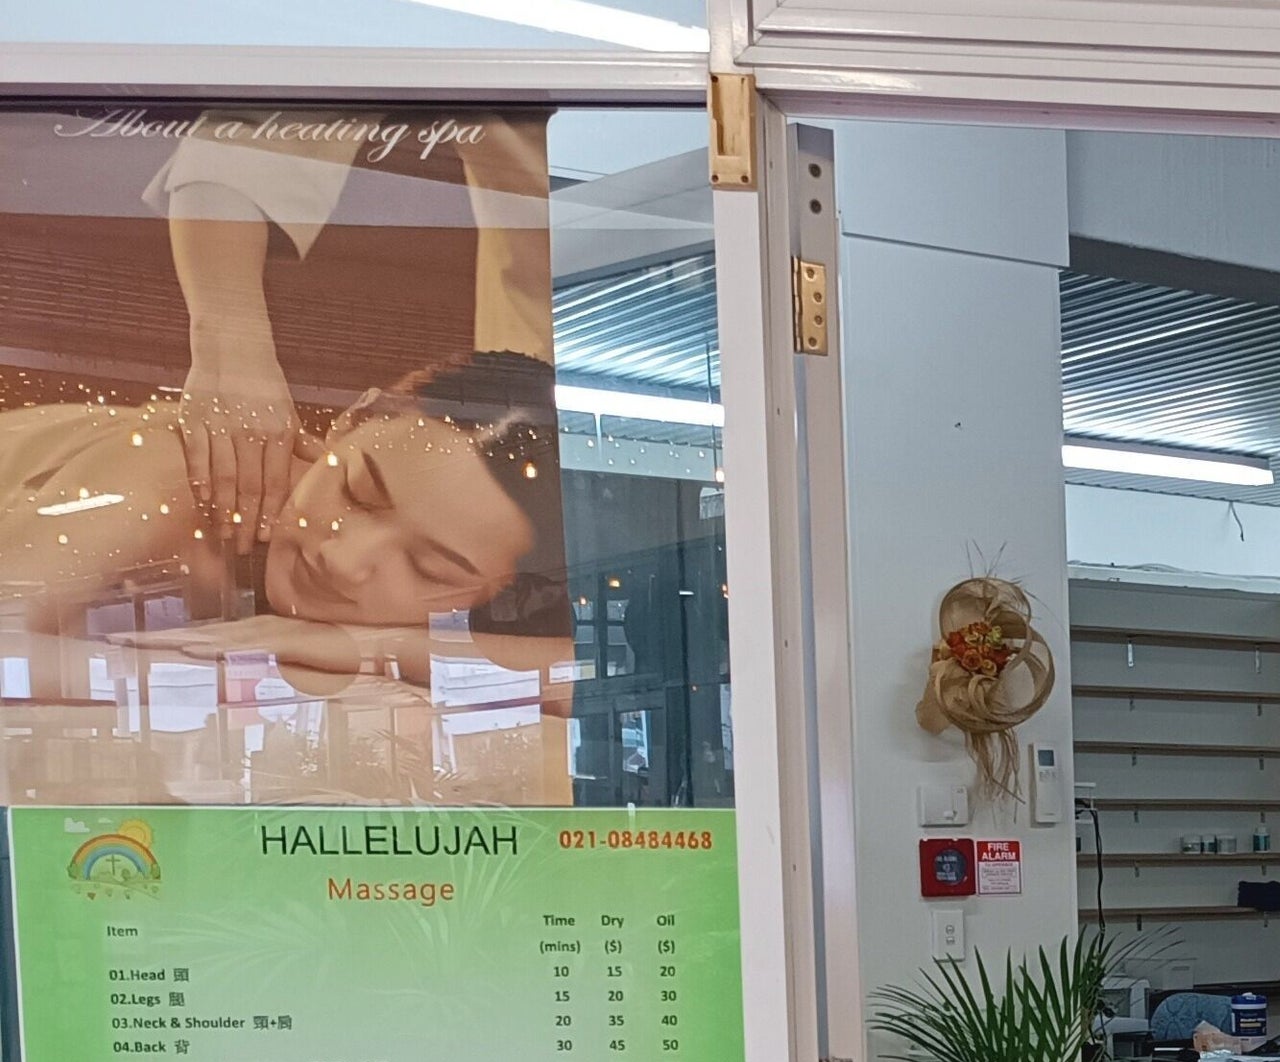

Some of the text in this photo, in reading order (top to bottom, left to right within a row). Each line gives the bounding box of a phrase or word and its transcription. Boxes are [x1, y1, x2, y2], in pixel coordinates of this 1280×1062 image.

[53, 108, 207, 138] About
[214, 118, 246, 141] a
[417, 119, 487, 161] spa
[261, 826, 517, 855] HALLELUJAH
[559, 831, 712, 849] 021-08484468
[987, 842, 1009, 851] FIRE
[982, 852, 1016, 860] ALARM
[328, 878, 454, 906] Massage
[543, 915, 575, 926] Time
[601, 915, 624, 928] Dry
[656, 914, 675, 926] Oil
[107, 926, 138, 937] Item
[539, 940, 581, 954] (mins)
[604, 939, 622, 954] ($)
[658, 940, 675, 954] ($)
[109, 969, 165, 981] 01.Head
[554, 966, 569, 977] 10
[607, 966, 622, 977] 15
[660, 966, 676, 977] 20
[110, 993, 161, 1007] 02.Legs
[112, 1017, 167, 1029] 03.Neck
[185, 1017, 245, 1028] Shoulder
[555, 1015, 571, 1026] 20
[609, 1015, 624, 1026] 35
[661, 1015, 678, 1026] 40
[113, 1041, 166, 1053] 04.Back
